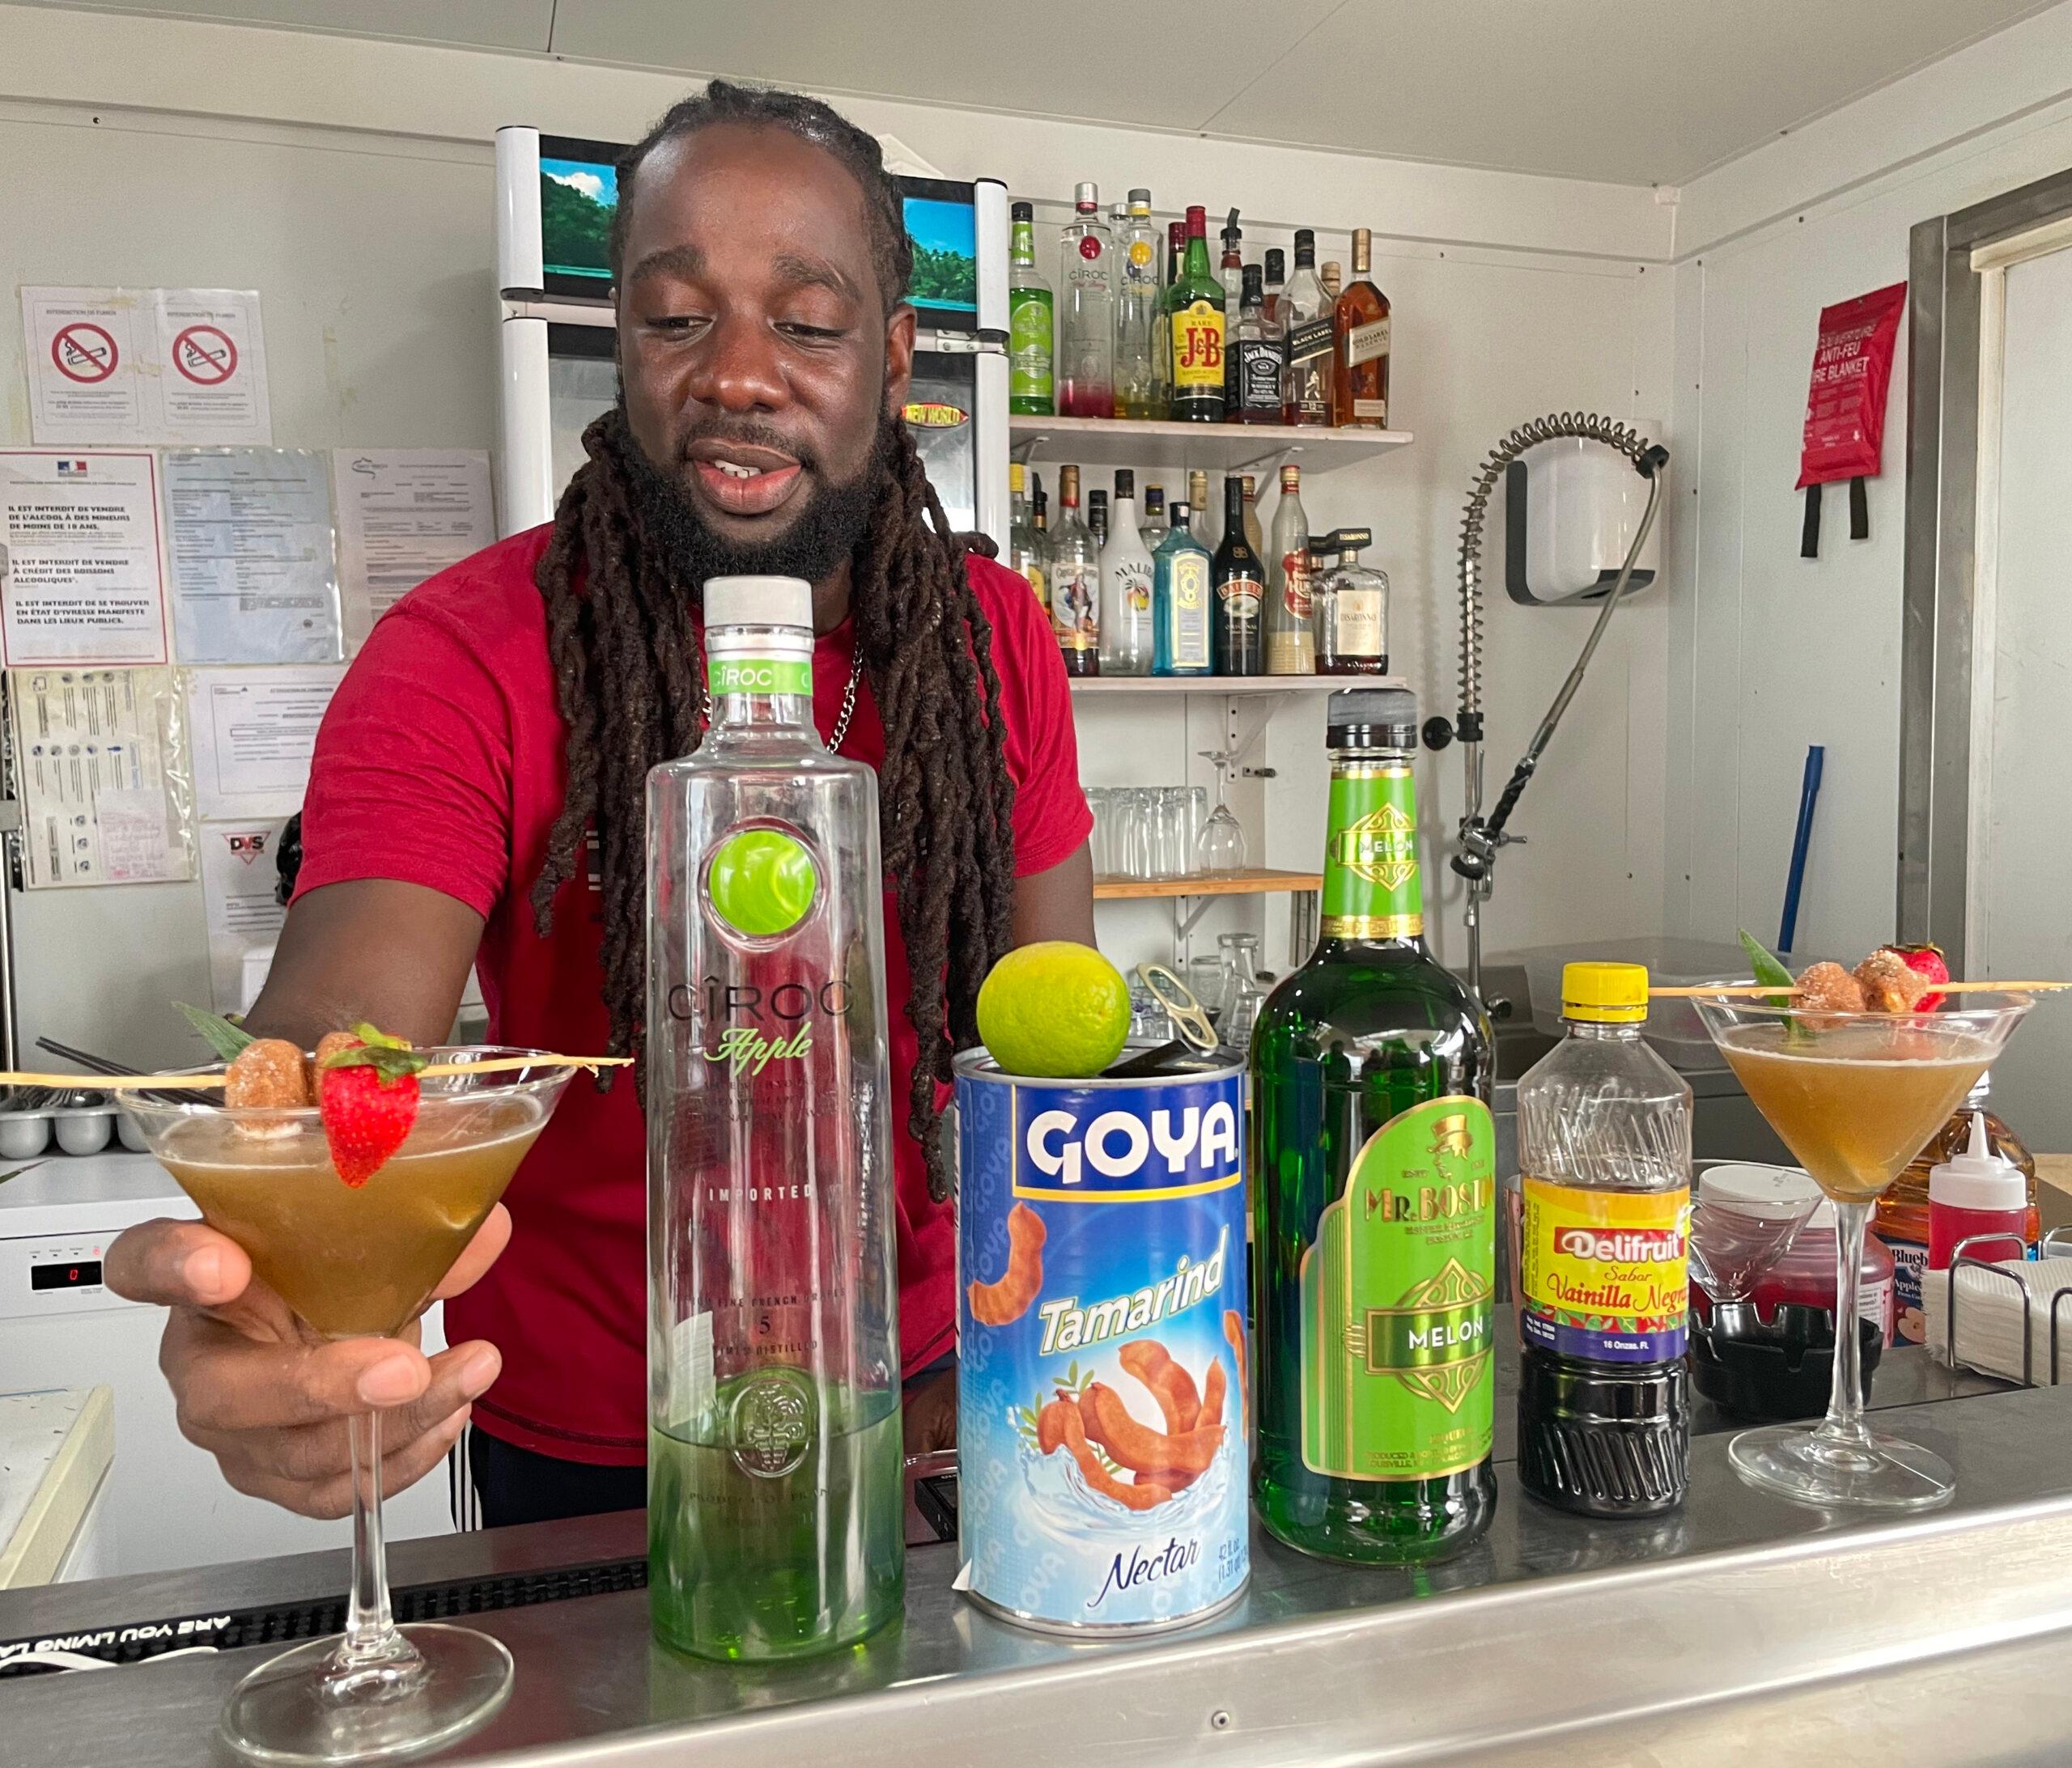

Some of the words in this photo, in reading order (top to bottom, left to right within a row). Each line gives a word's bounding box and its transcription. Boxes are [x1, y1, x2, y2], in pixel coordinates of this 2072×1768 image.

[1313, 328, 1333, 338] LABEL
[1180, 328, 1221, 367] J&B
[1819, 341, 1861, 365] ANTI-FEU
[1828, 356, 1870, 380] BLANKET
[1359, 839, 1413, 853] MELON
[668, 975, 853, 1021] CÎROC
[703, 1021, 813, 1076] Apple
[1026, 1101, 1237, 1184] GOYA
[708, 1184, 816, 1202] IMPORTED
[1560, 1230, 1682, 1263] Delifruit
[1604, 1266, 1653, 1282] Sabor
[751, 1295, 797, 1307] FRENCH
[1039, 1224, 1229, 1355] Tamarind
[1547, 1273, 1632, 1309] Vainilla
[758, 1316, 771, 1334] 5
[1408, 1315, 1484, 1350] MELON
[1087, 1537, 1201, 1608] Nectar
[120, 1624, 173, 1643] YOU
[177, 1616, 231, 1634] ARE
[35, 1631, 116, 1652] LIVING
